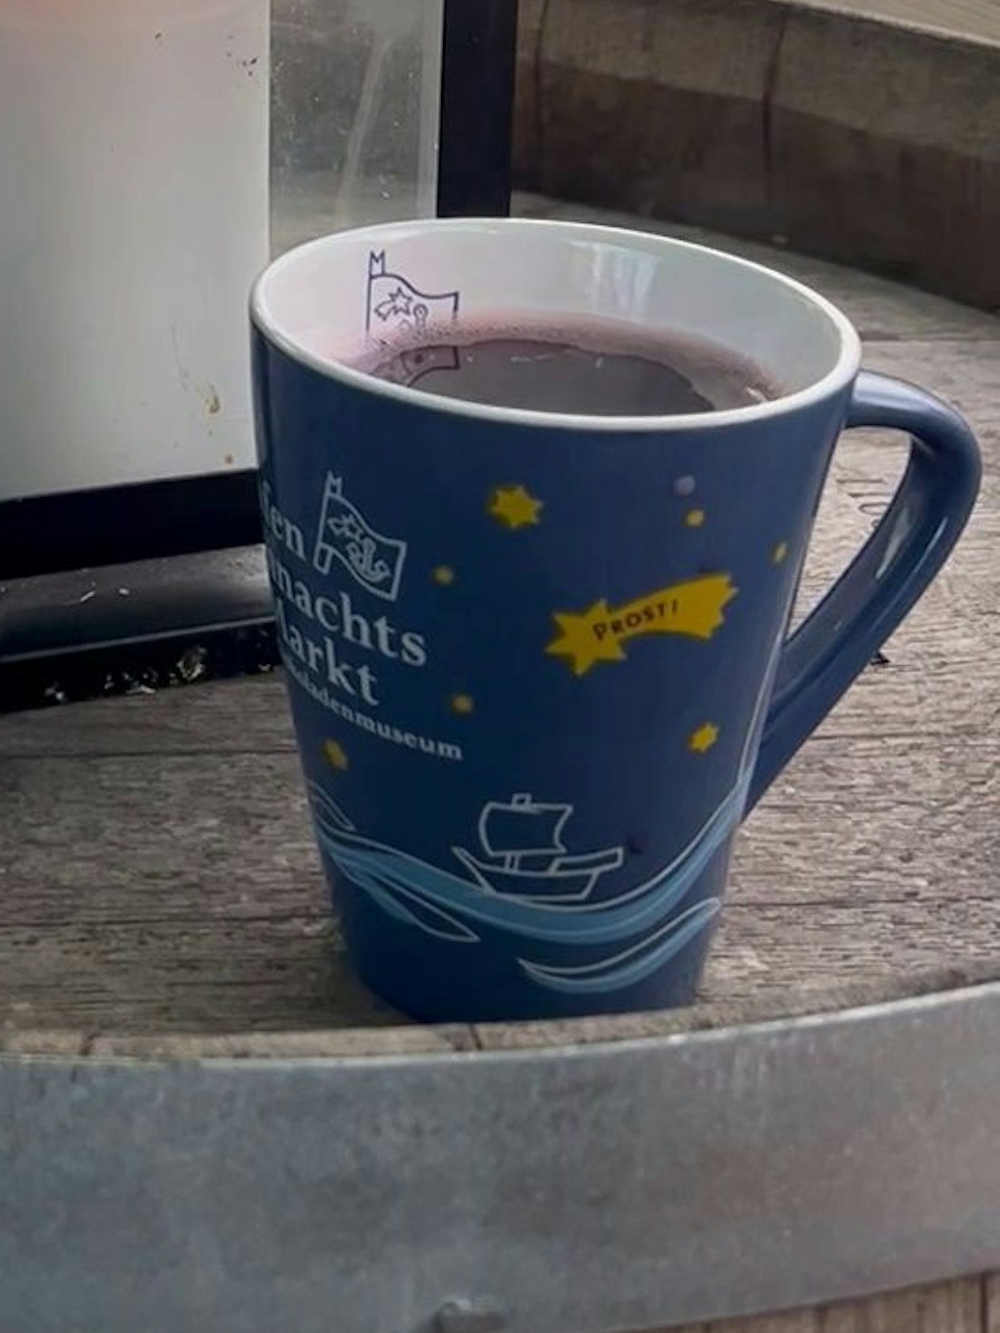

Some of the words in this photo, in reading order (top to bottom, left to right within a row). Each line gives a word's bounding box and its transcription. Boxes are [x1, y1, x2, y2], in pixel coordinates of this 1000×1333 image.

[268, 555, 428, 668] nachts
[277, 597, 380, 707] arkt
[592, 599, 678, 642] PROST!
